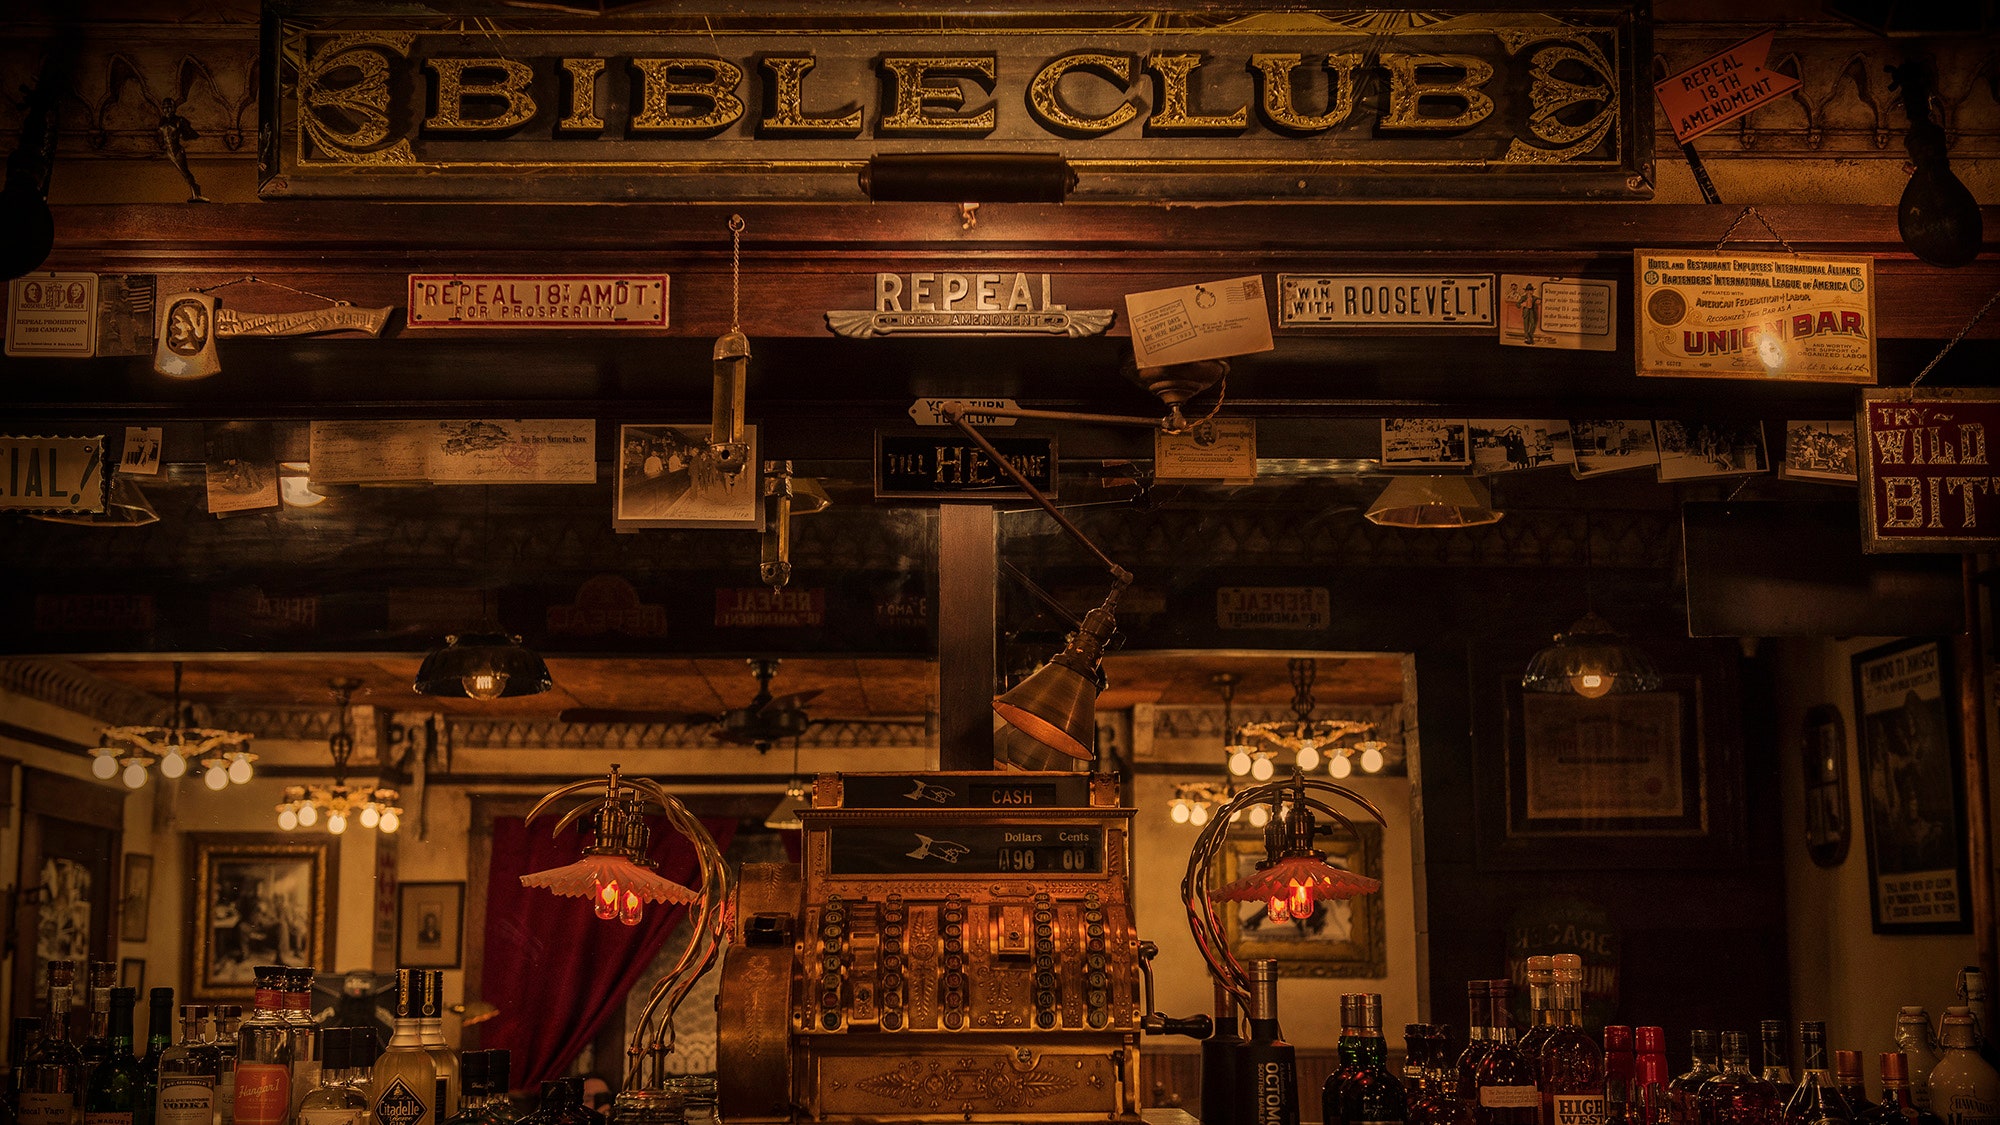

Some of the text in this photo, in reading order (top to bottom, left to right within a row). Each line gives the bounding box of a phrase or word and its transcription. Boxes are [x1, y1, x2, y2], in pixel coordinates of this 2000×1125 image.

[1682, 55, 1743, 91] REPEAL
[422, 53, 1496, 136] BIBLE CLUB
[1681, 77, 1772, 132] AMENDMENT
[1687, 259, 1732, 271] RESTAURANT
[1774, 262, 1827, 275] INTERNATIONAL
[1714, 274, 1771, 288] INTERNATIONAL
[1772, 277, 1802, 289] LEAGUE
[1812, 279, 1849, 291] AMERICA
[425, 285, 522, 306] REPEAL
[875, 272, 1067, 311] REPEAL
[1298, 288, 1329, 298] WIN
[1292, 301, 1334, 314] WITH
[1344, 286, 1479, 316] ROOSEVELT
[217, 310, 238, 324] ALL
[456, 306, 616, 318] FOR PROSPERITY
[950, 314, 1042, 327] AMENDMENT
[1792, 311, 1869, 341] BAR
[962, 414, 996, 424] LOW
[1878, 408, 1930, 425] TRY
[1874, 423, 1989, 465] WILD
[888, 454, 927, 475] TILL
[934, 446, 996, 484] HE
[0, 444, 100, 504] IAL!
[1881, 476, 2000, 528] BIT
[992, 789, 1033, 805] CASH
[1005, 831, 1089, 842] Dollars Cents
[1063, 849, 1085, 870] 00
[238, 1084, 274, 1098] Hangar
[1265, 1062, 1281, 1125] OCTOM
[379, 1101, 420, 1116] Citadelle
[1558, 1100, 1604, 1115] HIGH
[1559, 1115, 1604, 1125] WEST
